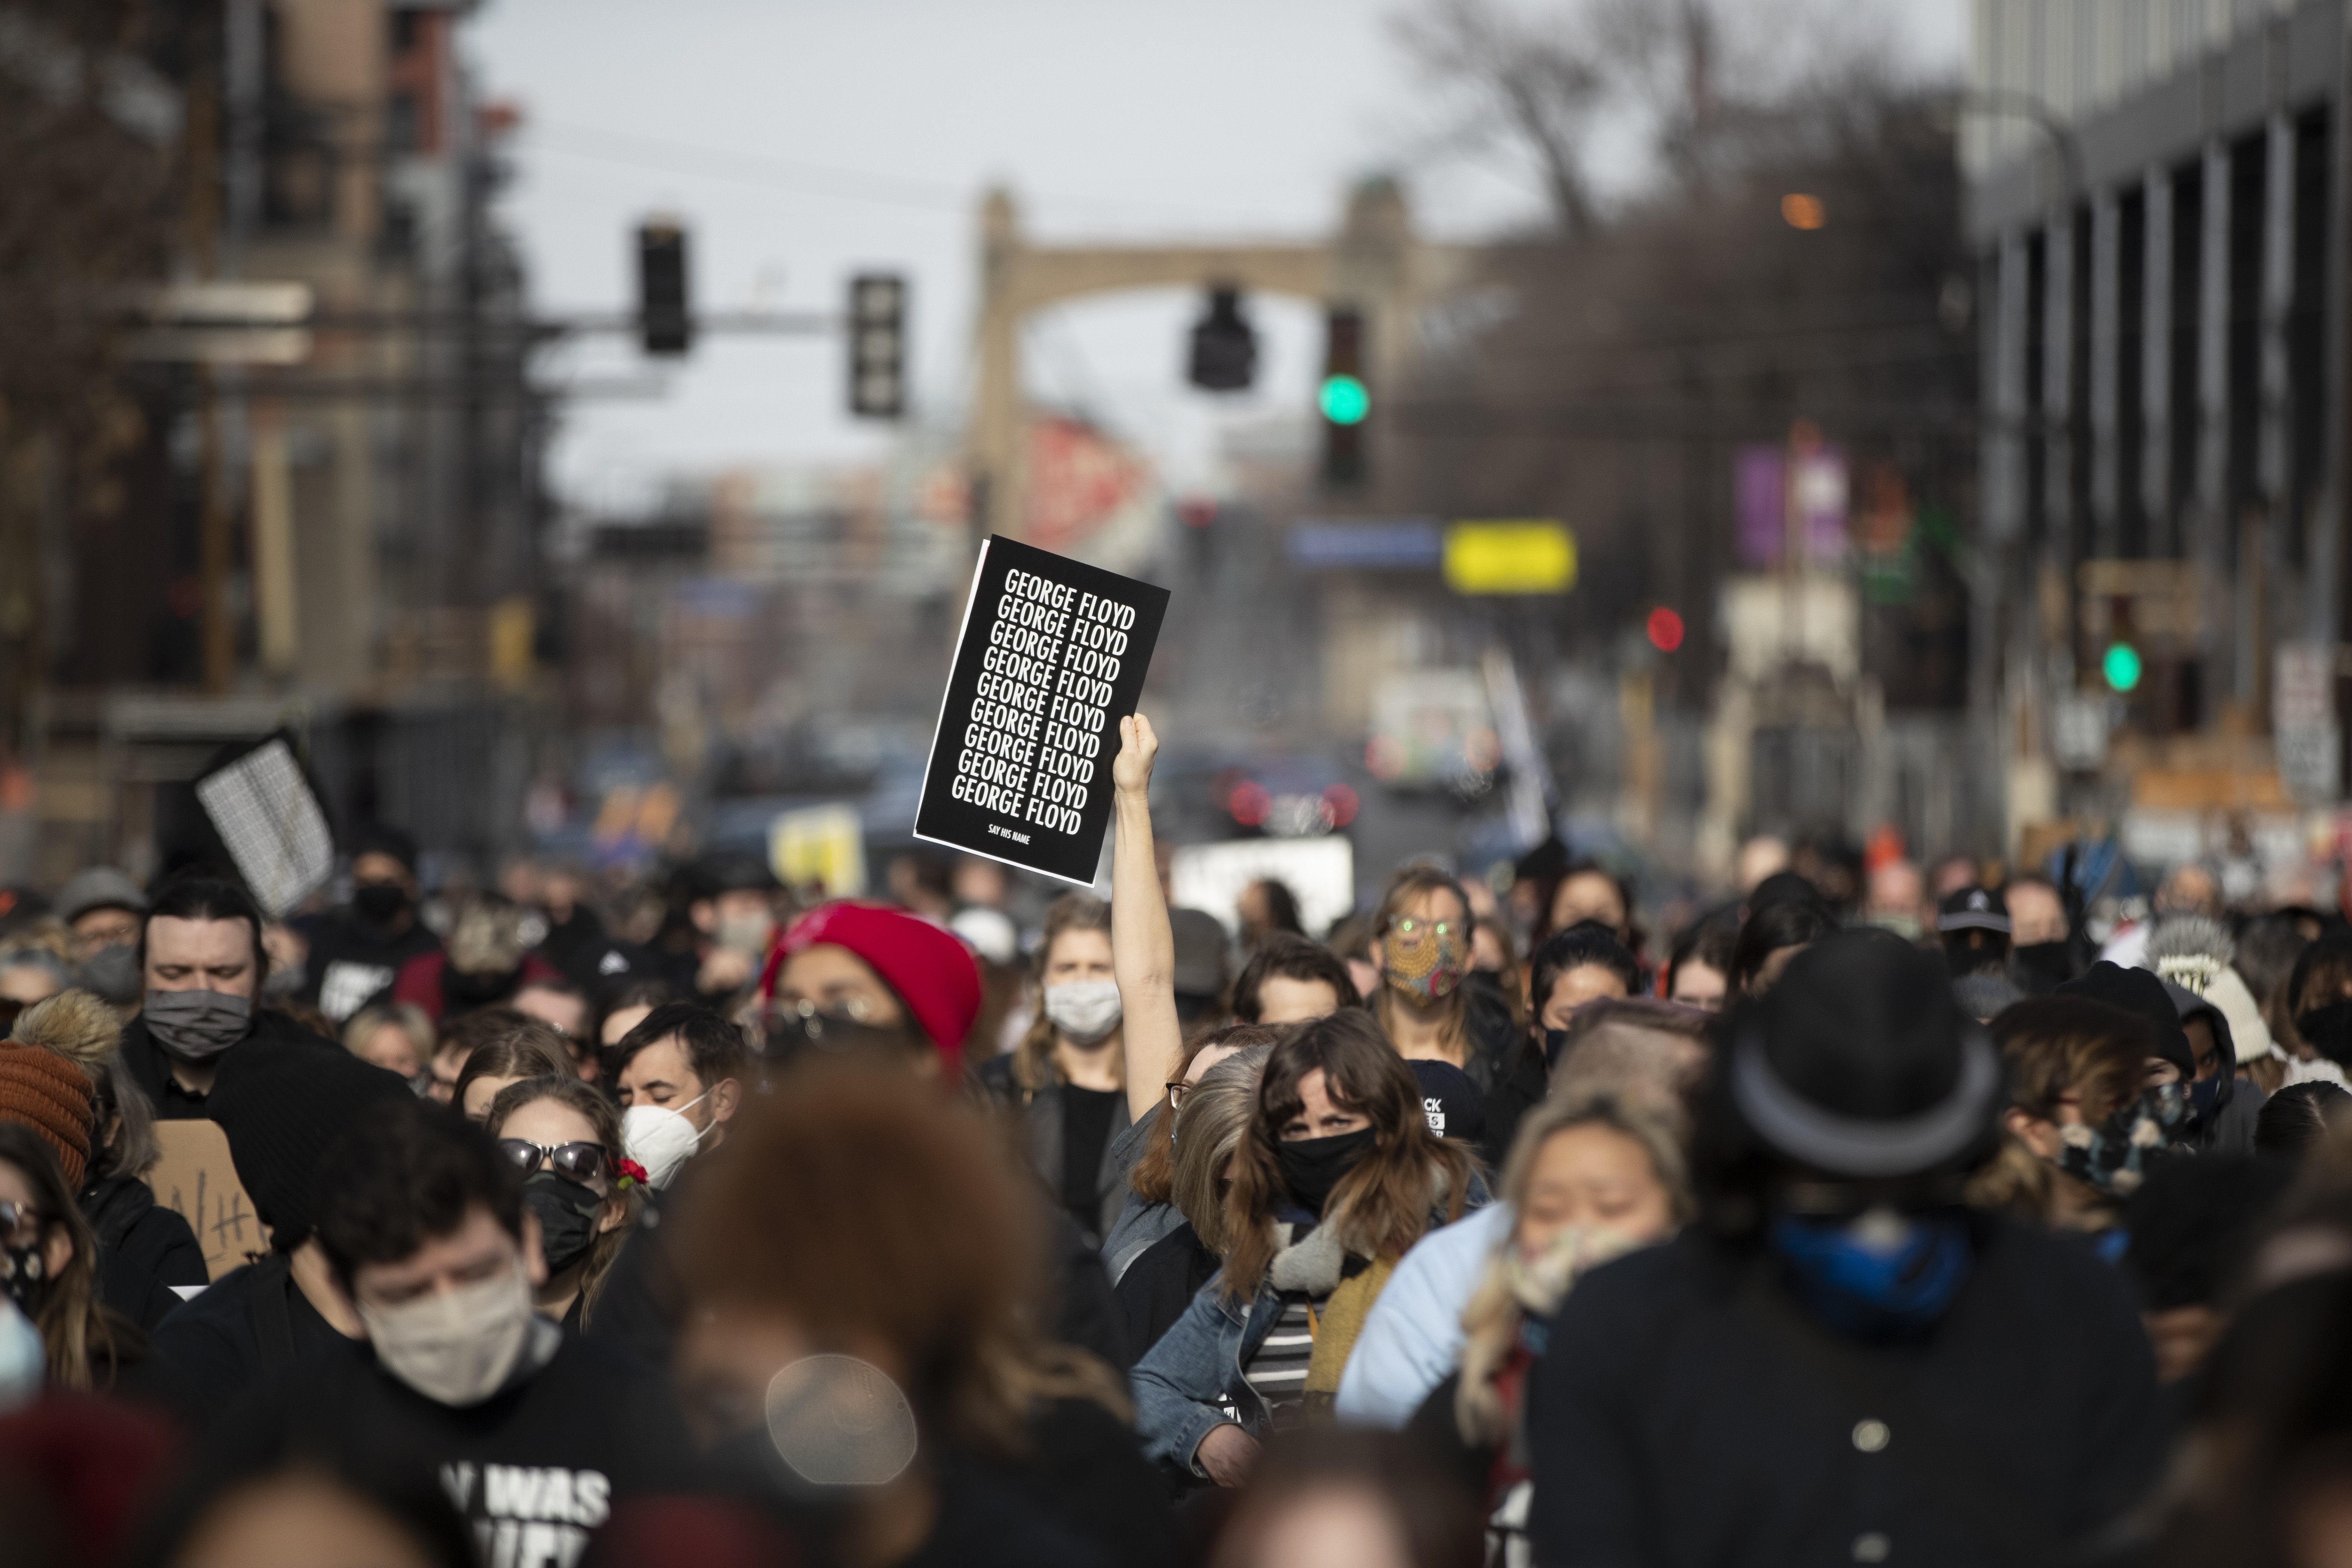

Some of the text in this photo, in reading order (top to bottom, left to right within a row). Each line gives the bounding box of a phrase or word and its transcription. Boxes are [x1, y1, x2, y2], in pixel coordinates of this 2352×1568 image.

[998, 594, 1127, 655] GEORGE FLOYD
[1005, 569, 1135, 630] GEORGE FLOYD
[984, 646, 1112, 707] GEORGE FLOYD
[991, 620, 1120, 681] GEORGE FLOYD
[971, 698, 1099, 758] GEORGE FLOYD
[977, 672, 1105, 732] GEORGE FLOYD
[959, 749, 1087, 809] GEORGE FLOYD
[965, 723, 1093, 783] GEORGE FLOYD
[952, 775, 1081, 835] GEORGE FLOYD
[988, 824, 1031, 845] SAY HIS NAME
[1421, 1097, 1442, 1112] CK
[484, 1463, 611, 1528] WAS
